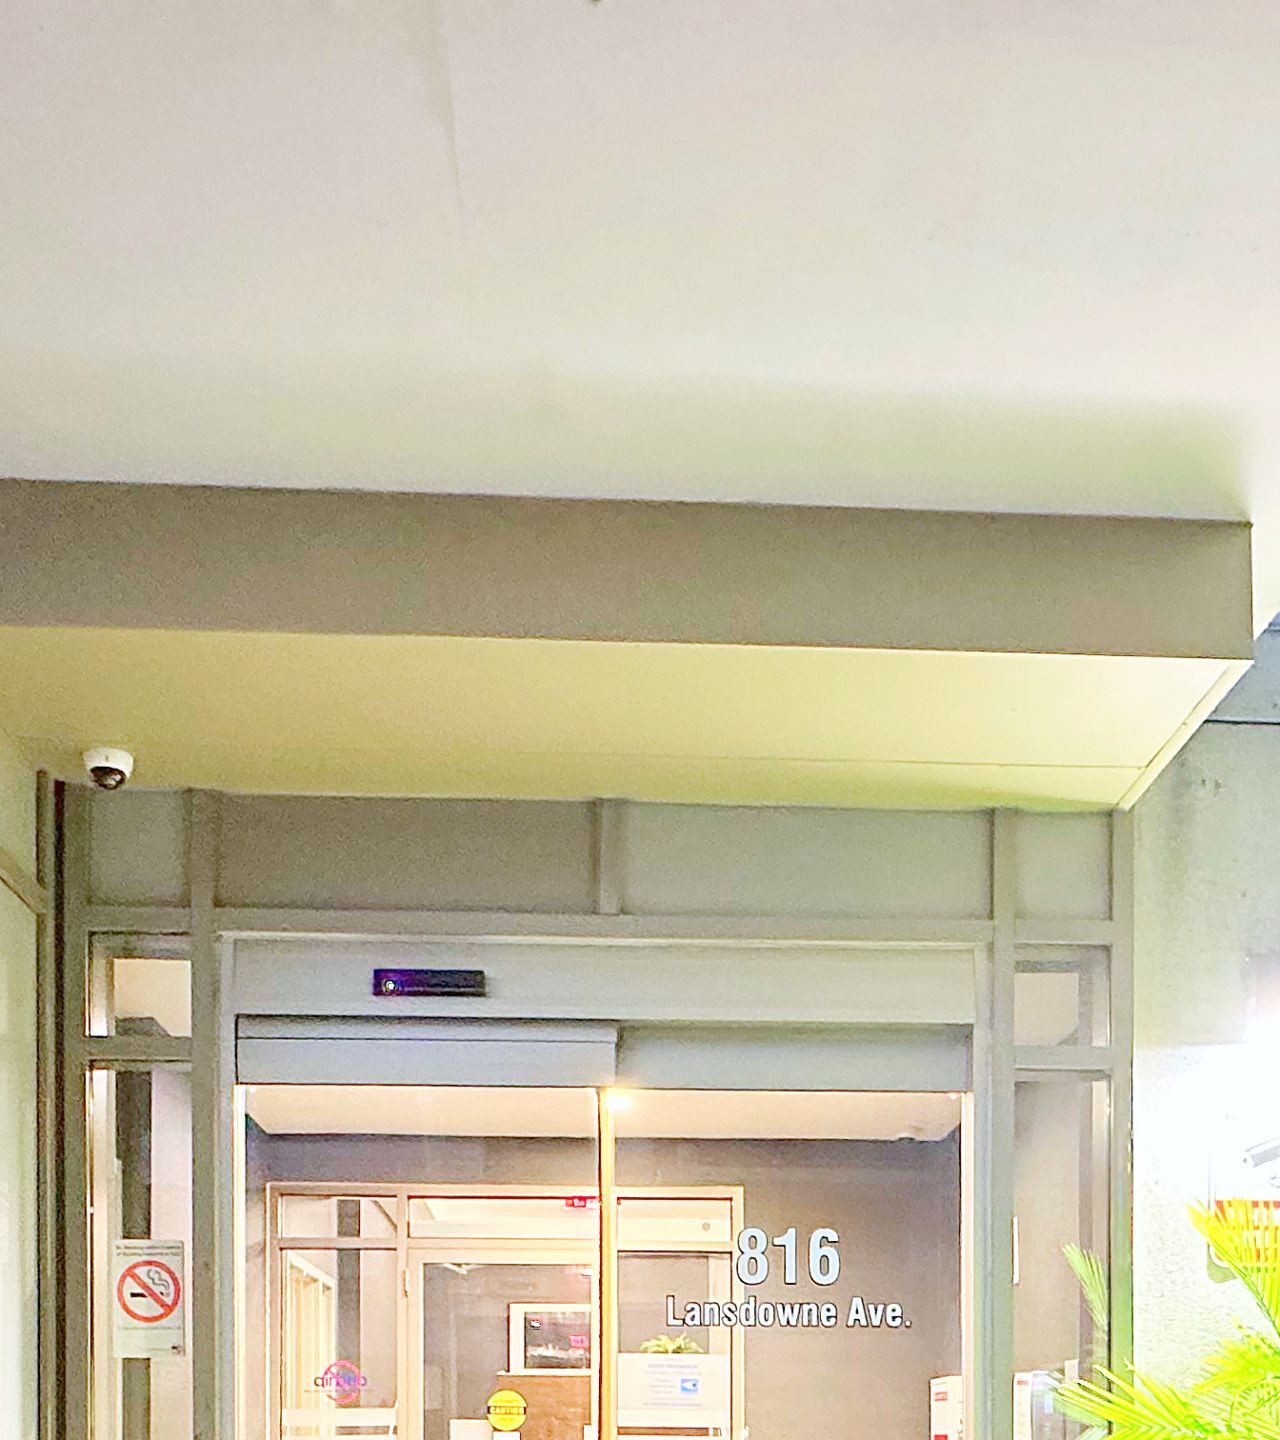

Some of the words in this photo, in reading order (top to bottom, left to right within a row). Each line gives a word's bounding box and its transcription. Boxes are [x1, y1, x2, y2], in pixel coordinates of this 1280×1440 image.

[736, 1226, 841, 1286] 816
[665, 1295, 837, 1327] Lansdowne
[846, 1296, 912, 1327] Ave.
